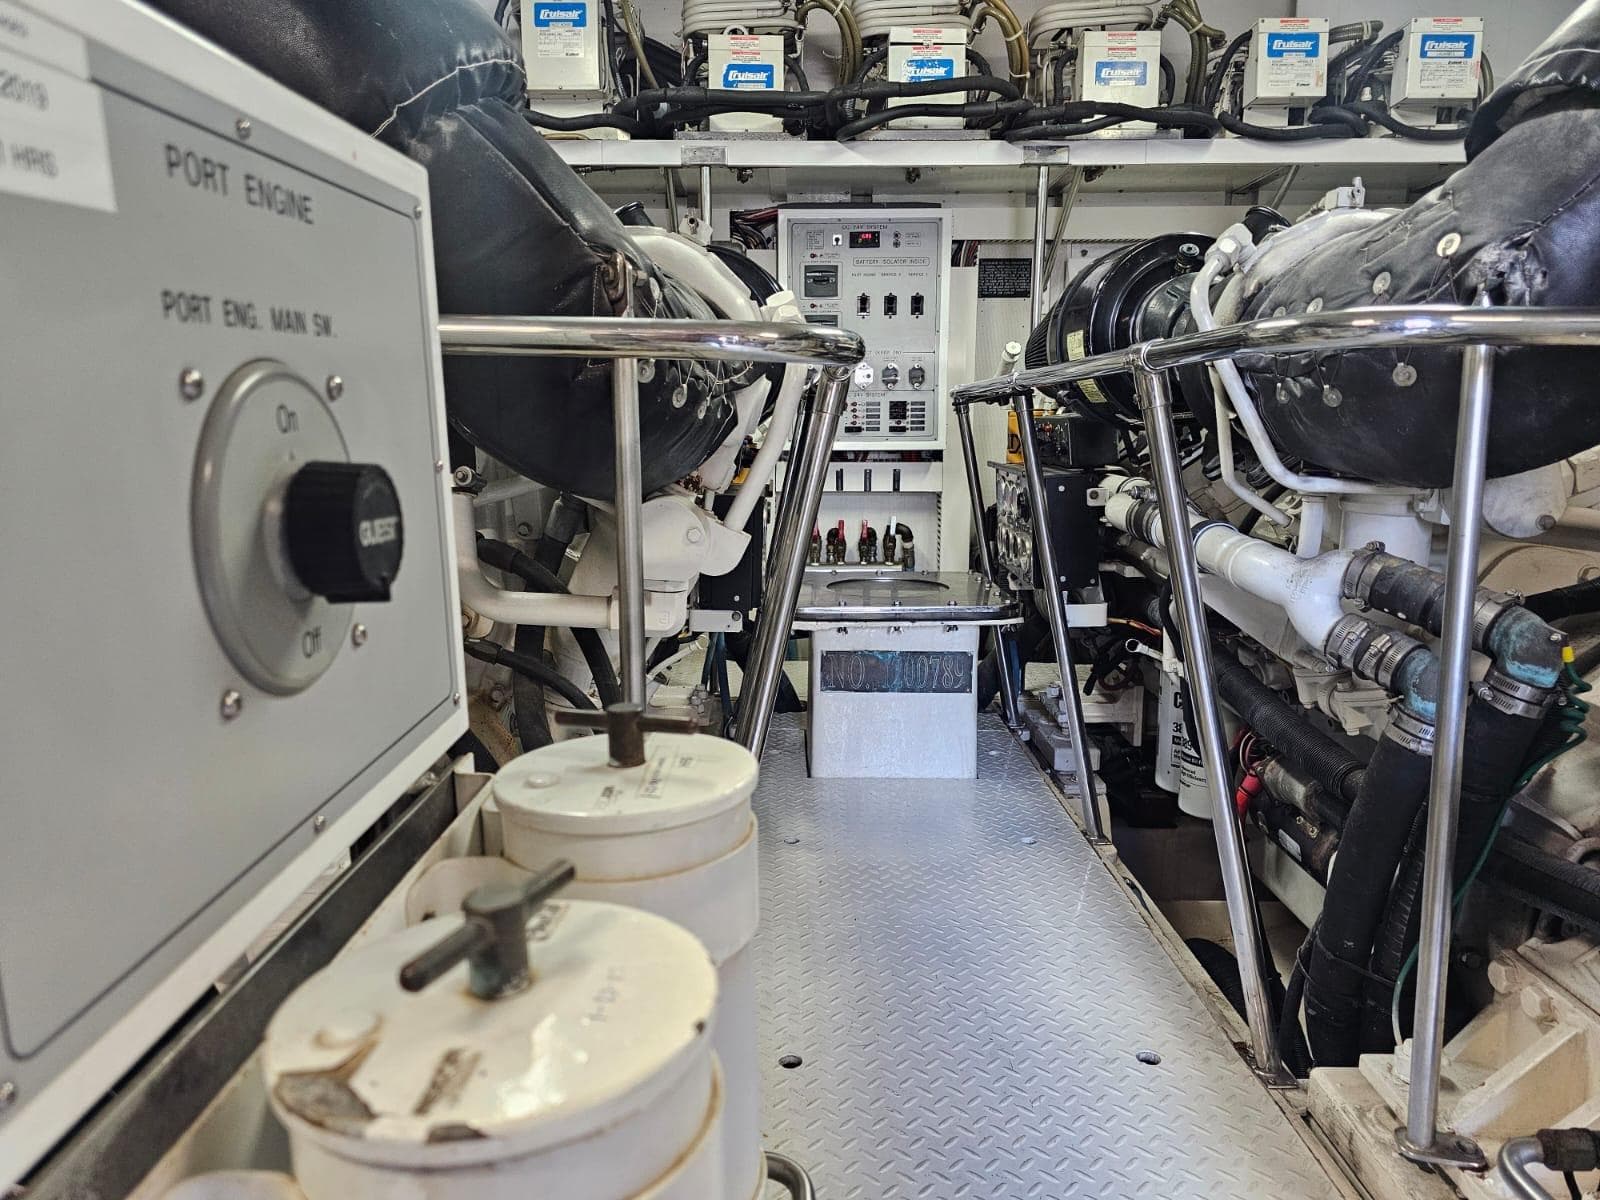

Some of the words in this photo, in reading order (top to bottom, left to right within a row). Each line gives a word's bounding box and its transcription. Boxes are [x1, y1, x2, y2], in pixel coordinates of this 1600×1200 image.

[728, 70, 771, 81] Cruisair
[164, 144, 231, 197] PORT
[244, 174, 315, 225] ENGINE
[161, 289, 212, 324] PORT
[223, 299, 263, 329] ENG.
[270, 306, 308, 335] MAIN
[276, 404, 299, 434] On
[302, 625, 323, 658] Off
